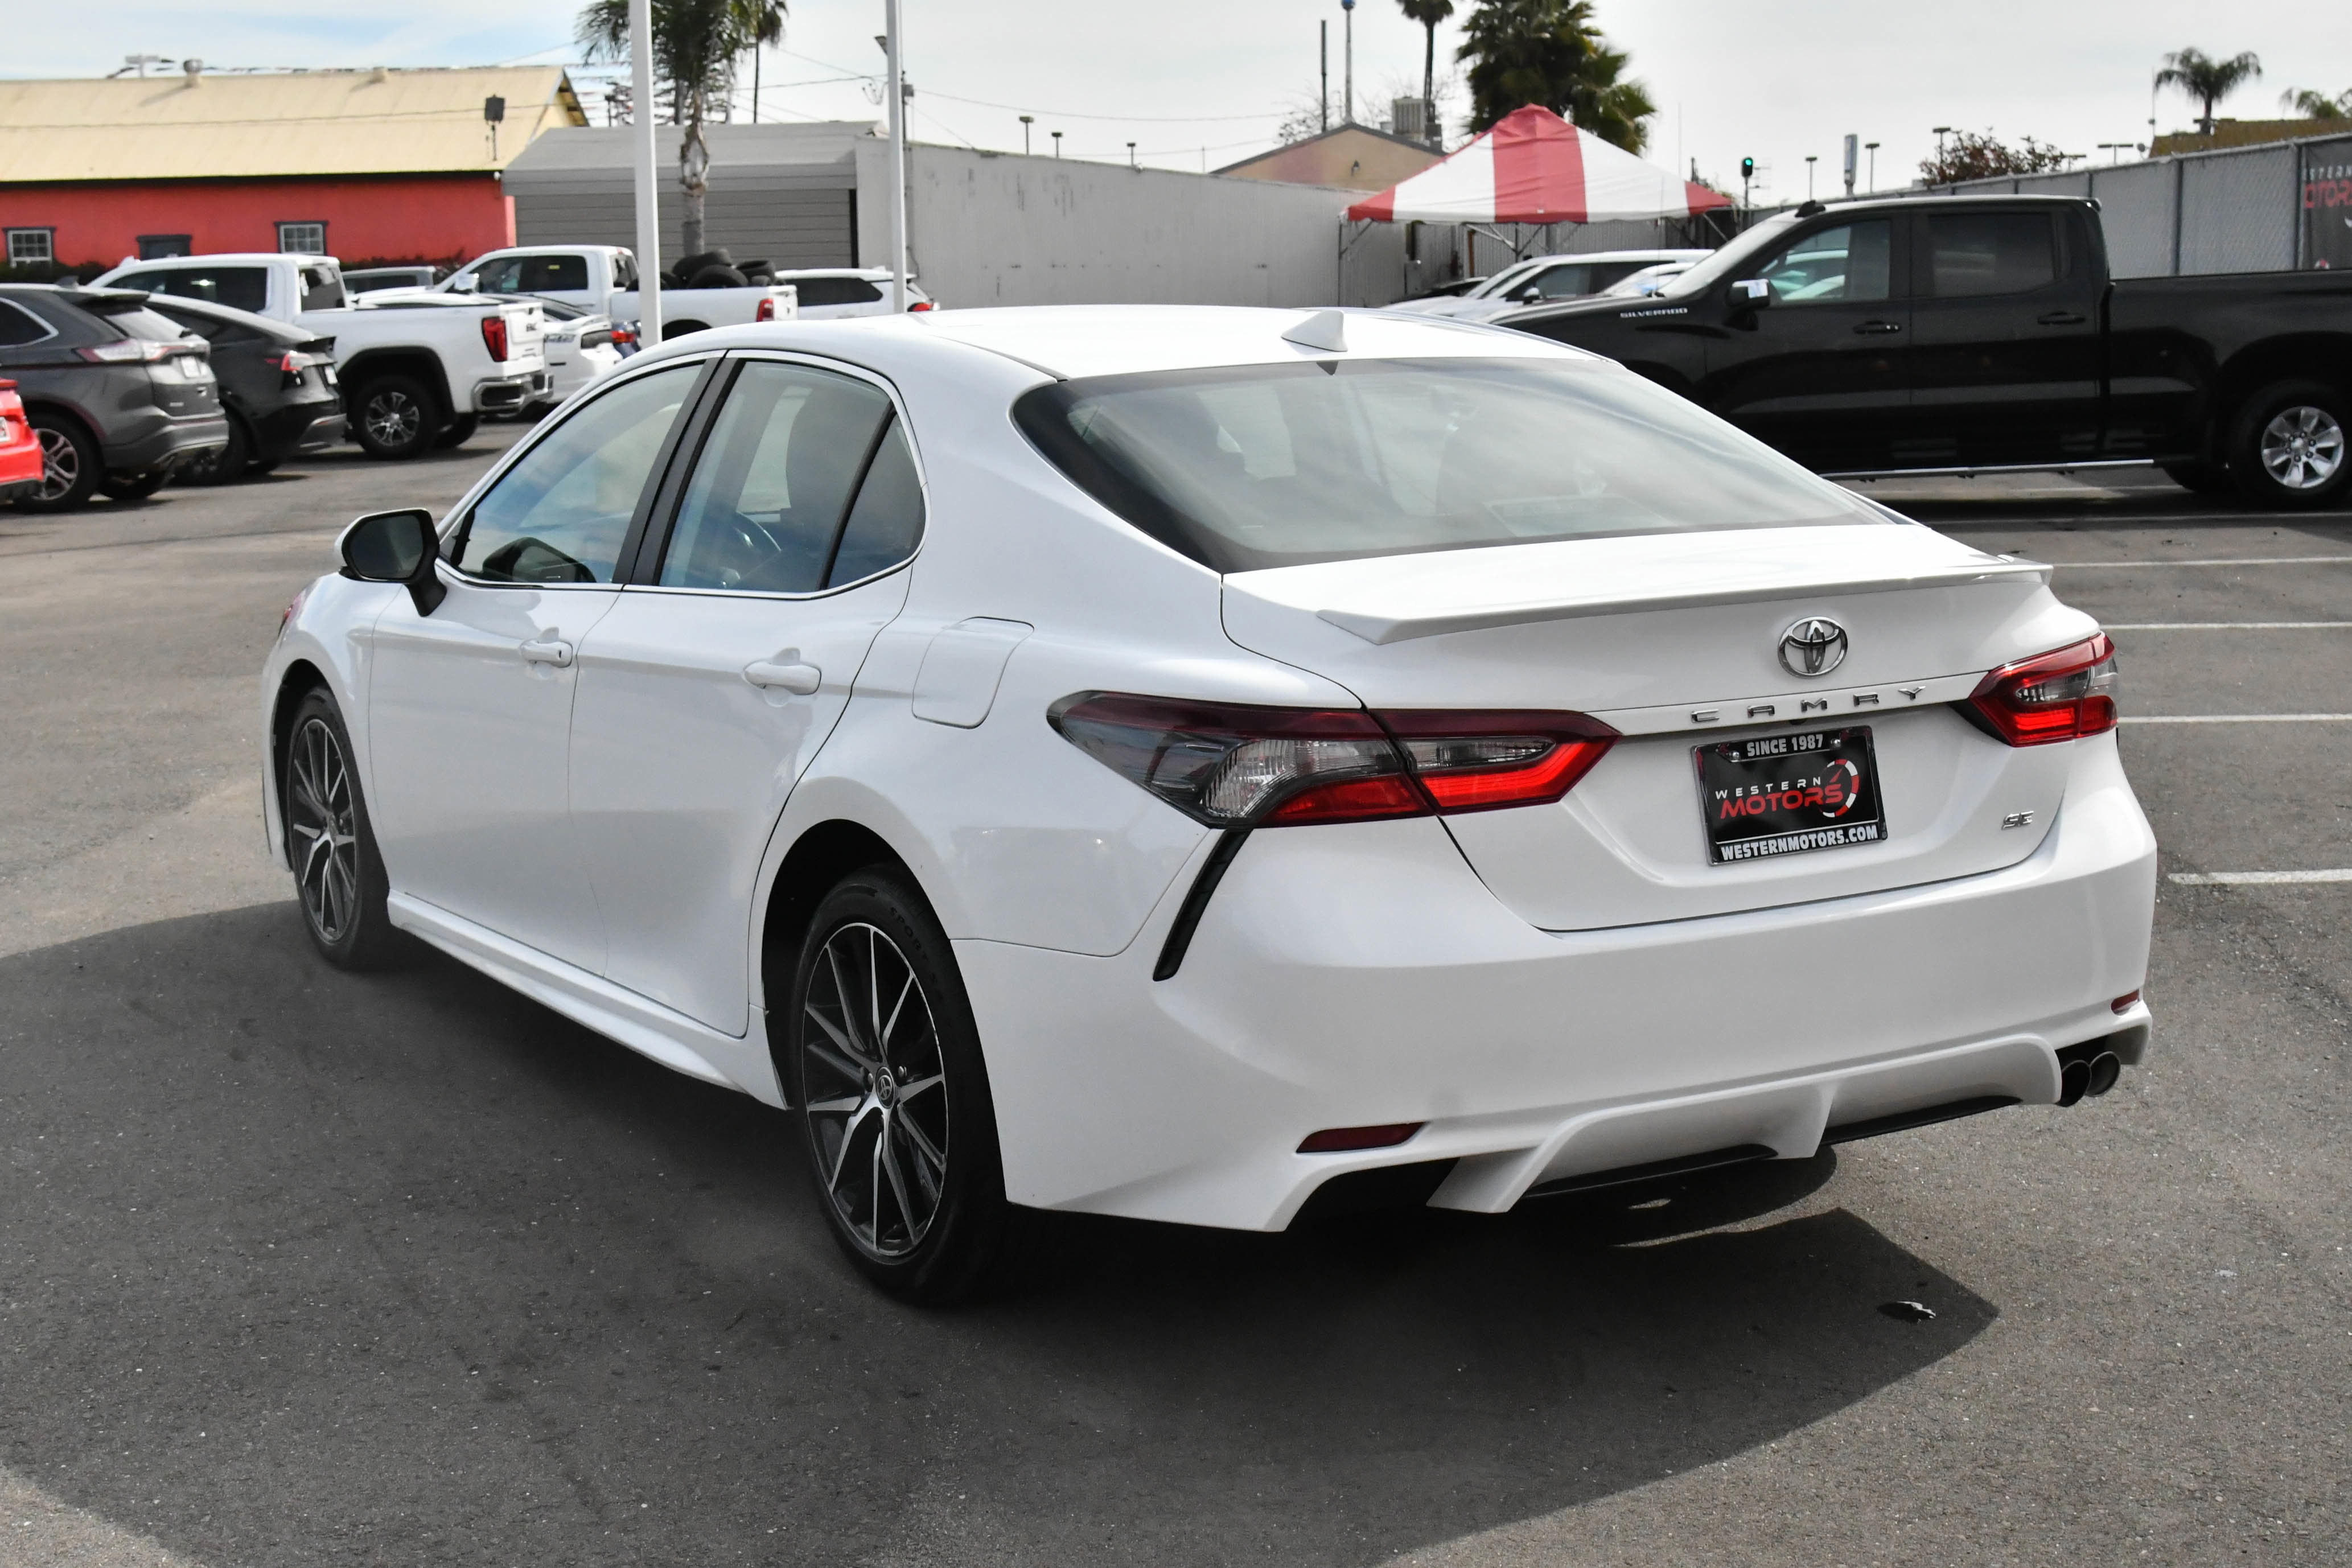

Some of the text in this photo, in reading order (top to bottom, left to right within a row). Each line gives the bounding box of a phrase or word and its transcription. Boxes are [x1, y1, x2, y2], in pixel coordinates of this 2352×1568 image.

[1619, 307, 1688, 318] SILVERADO
[1691, 686, 1926, 723] CAMRY
[1747, 734, 1823, 757] SINCE 1987
[1715, 776, 1821, 799] WESTERN
[1720, 783, 1844, 820] MOTORS
[2001, 810, 2034, 831] SE
[1720, 825, 1878, 861] WESTERNMOTORS.COM
